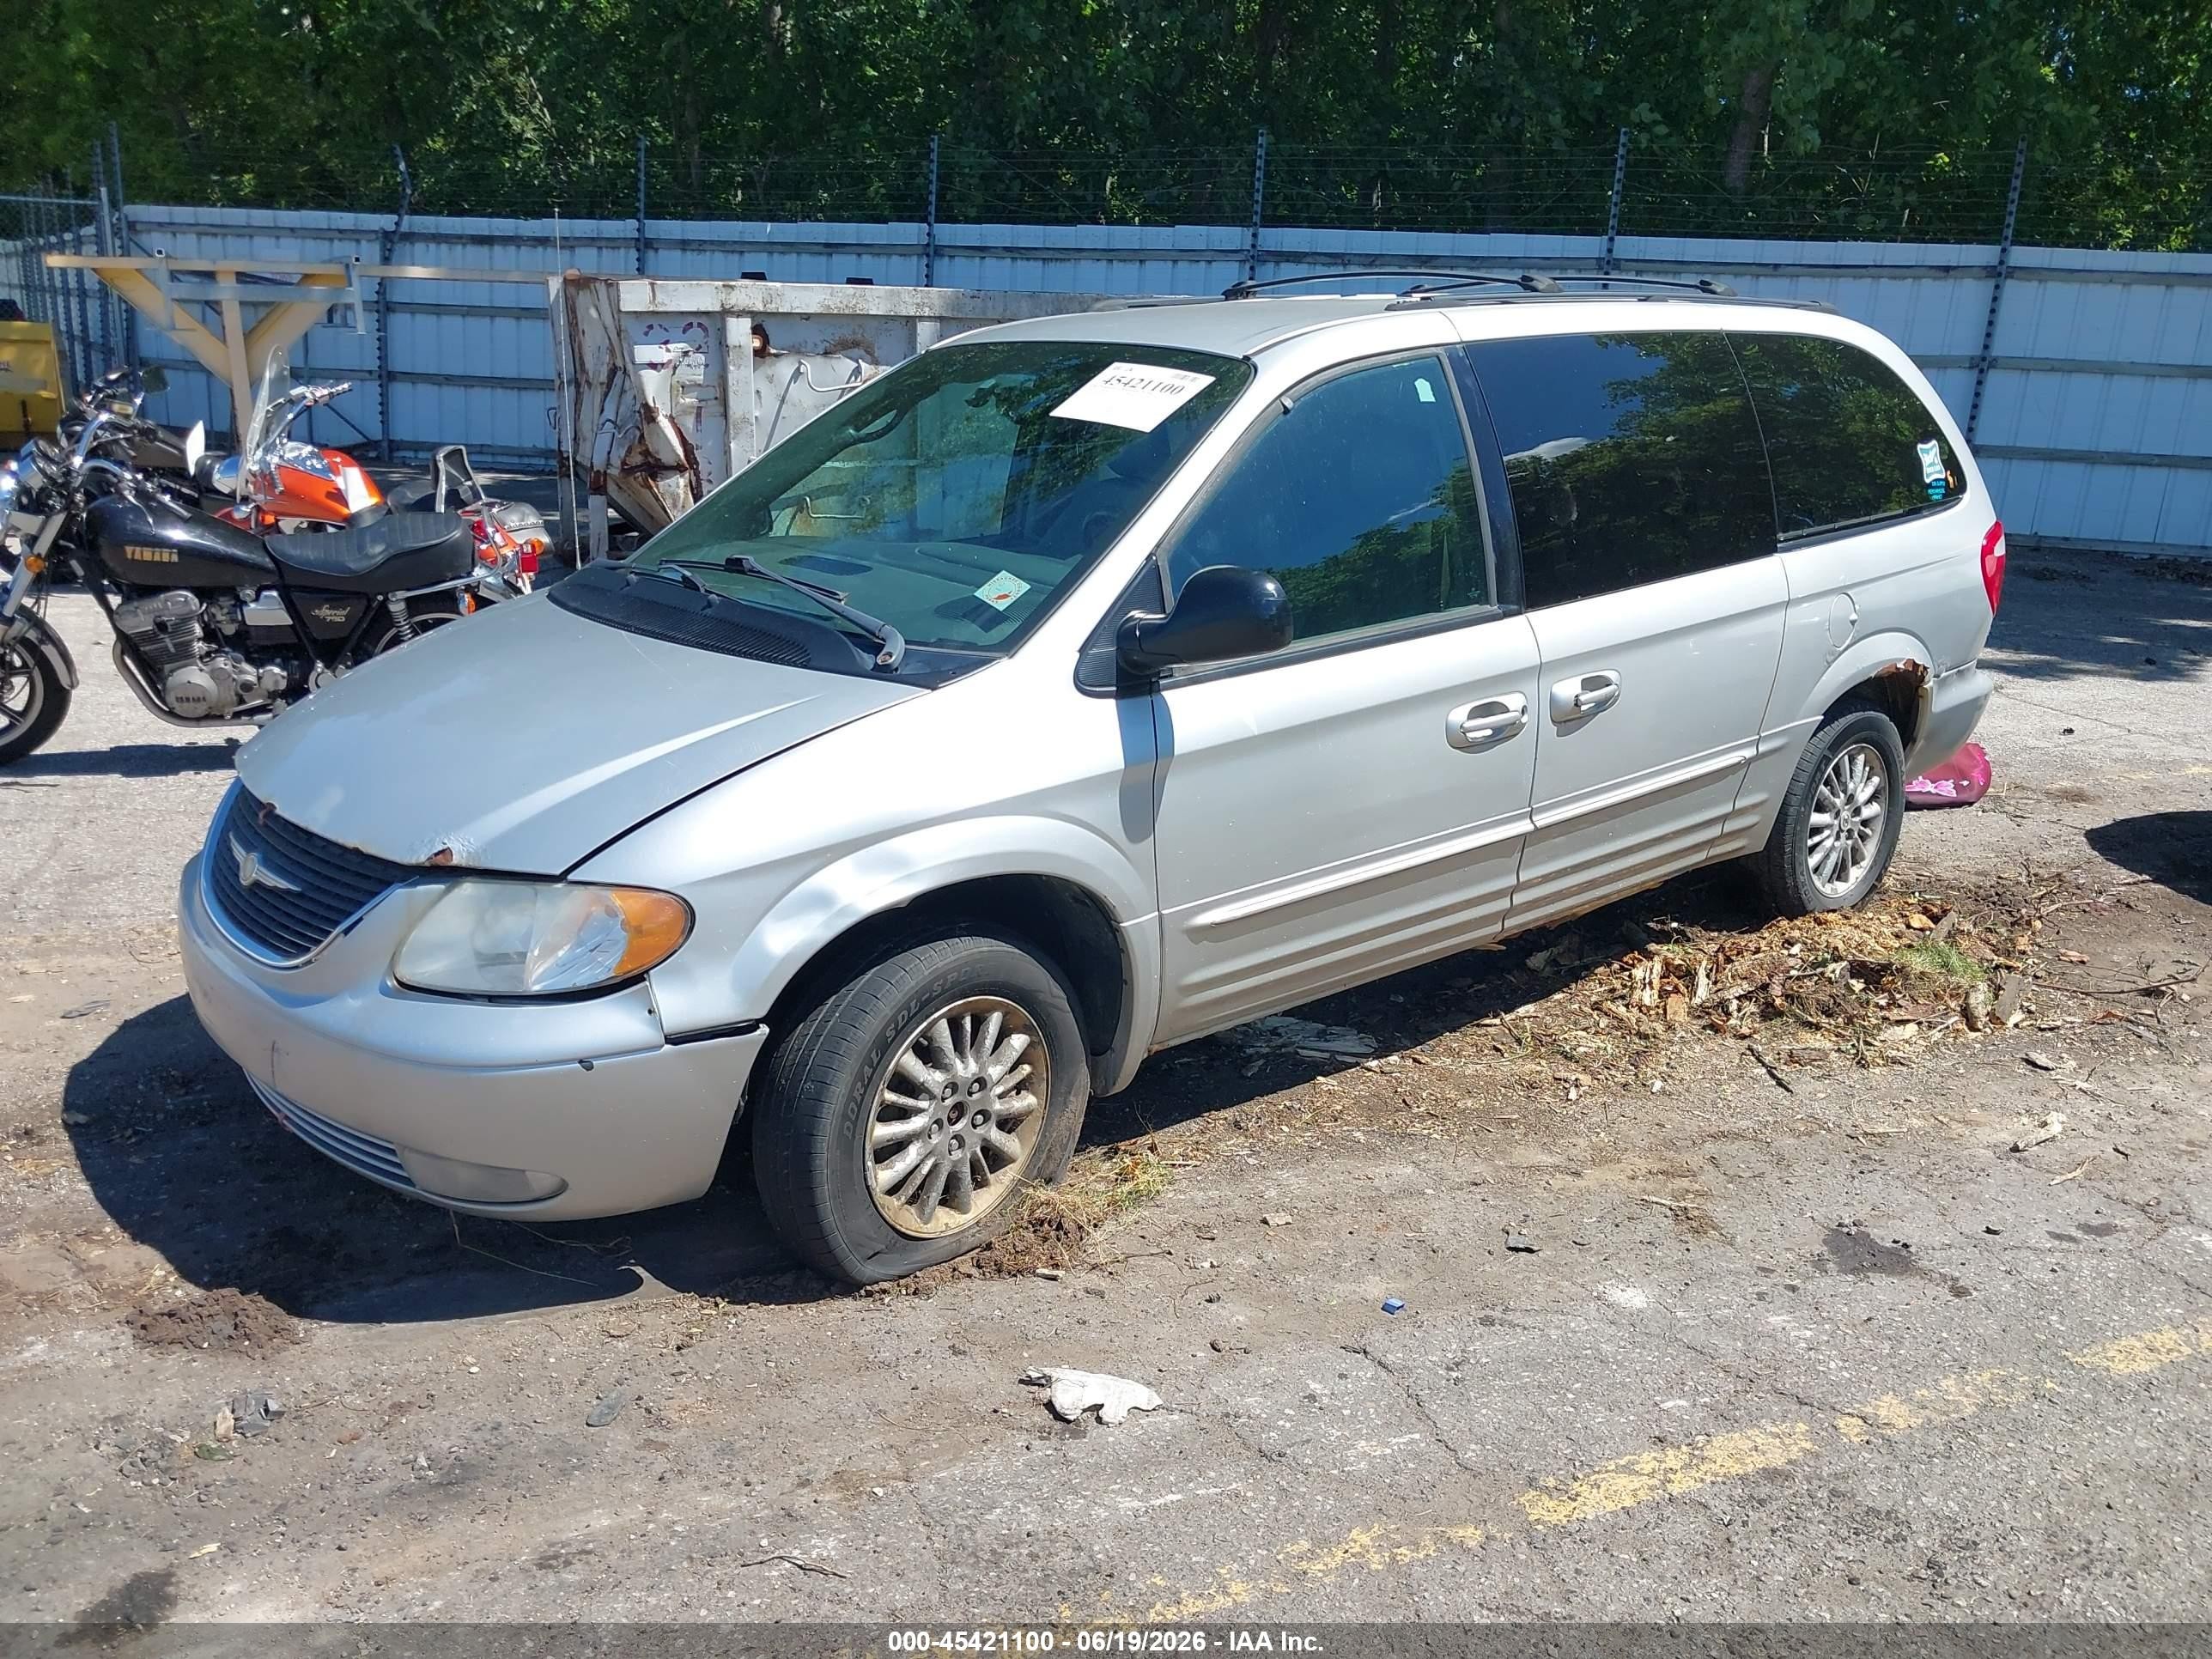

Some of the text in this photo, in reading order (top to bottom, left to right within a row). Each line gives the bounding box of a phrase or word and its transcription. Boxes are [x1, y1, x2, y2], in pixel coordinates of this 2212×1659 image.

[1103, 375, 1186, 395] 45421100
[124, 546, 179, 562] YAMAHA
[843, 1048, 882, 1140] DORAL
